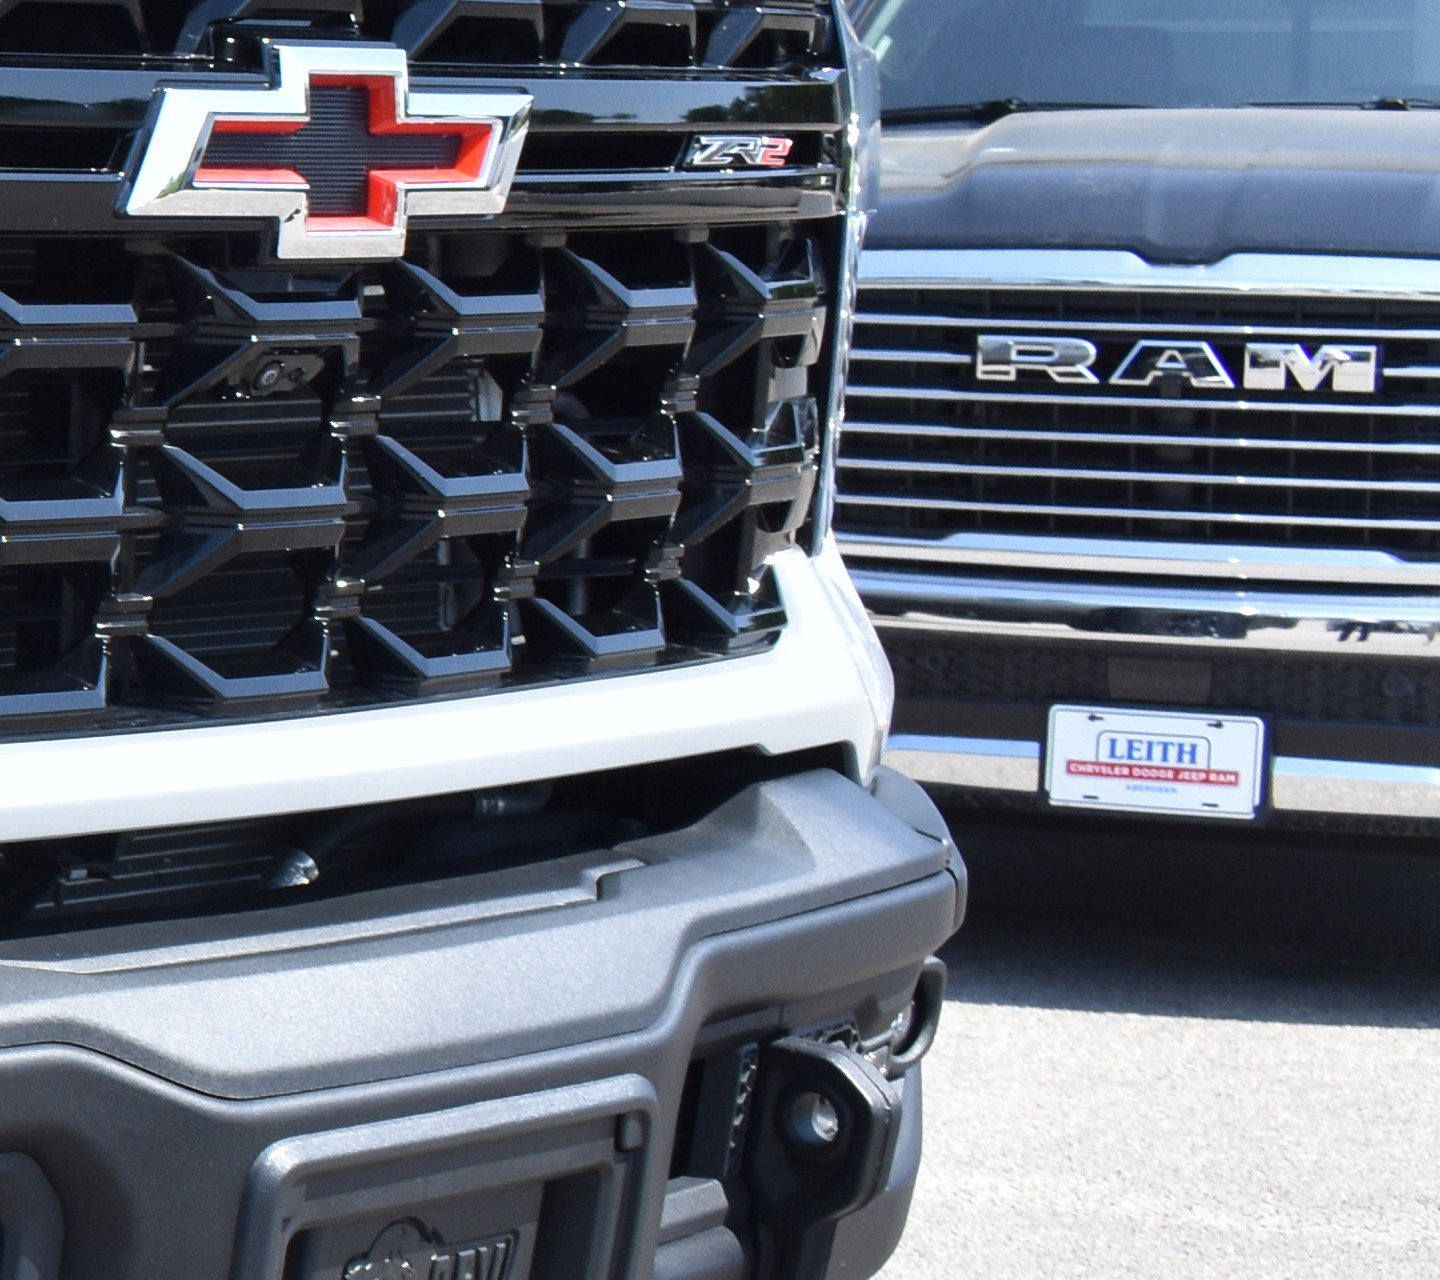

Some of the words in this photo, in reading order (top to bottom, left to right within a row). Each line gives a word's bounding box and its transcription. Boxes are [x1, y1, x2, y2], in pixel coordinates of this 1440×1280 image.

[692, 134, 794, 166] ZR2
[975, 333, 1377, 392] RAM
[1108, 737, 1199, 765] LEITH
[1069, 763, 1130, 777] CHRYSLER
[1132, 766, 1175, 780] DODGE
[1177, 770, 1207, 782] JEEP
[1209, 772, 1237, 784] RAM
